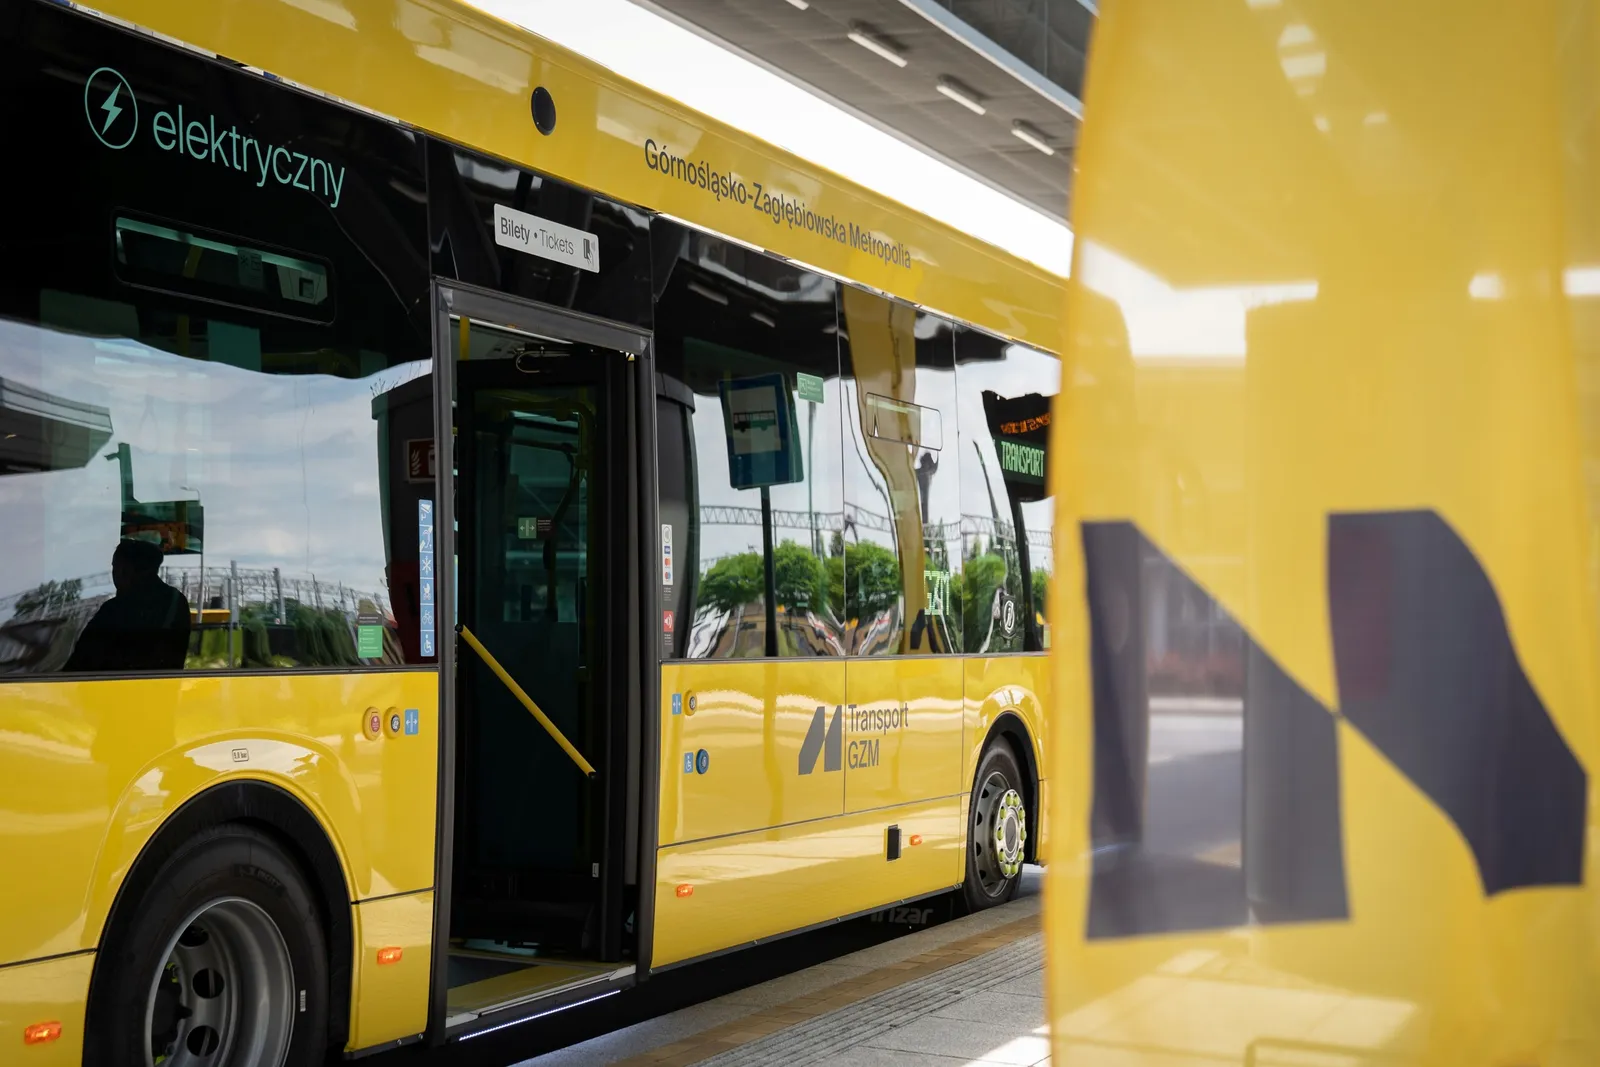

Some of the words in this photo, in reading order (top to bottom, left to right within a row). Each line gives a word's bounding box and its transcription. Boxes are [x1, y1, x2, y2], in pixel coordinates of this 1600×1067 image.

[153, 104, 345, 208] elektryczny
[644, 138, 847, 244] Górnośląsko-Zagłębiowska
[849, 222, 911, 269] Metropolia
[501, 217, 530, 245] Bilety
[539, 228, 574, 255] Tickets
[1001, 441, 1045, 477] TRANSPORT
[847, 702, 909, 736] Transport
[848, 738, 880, 770] GZM
